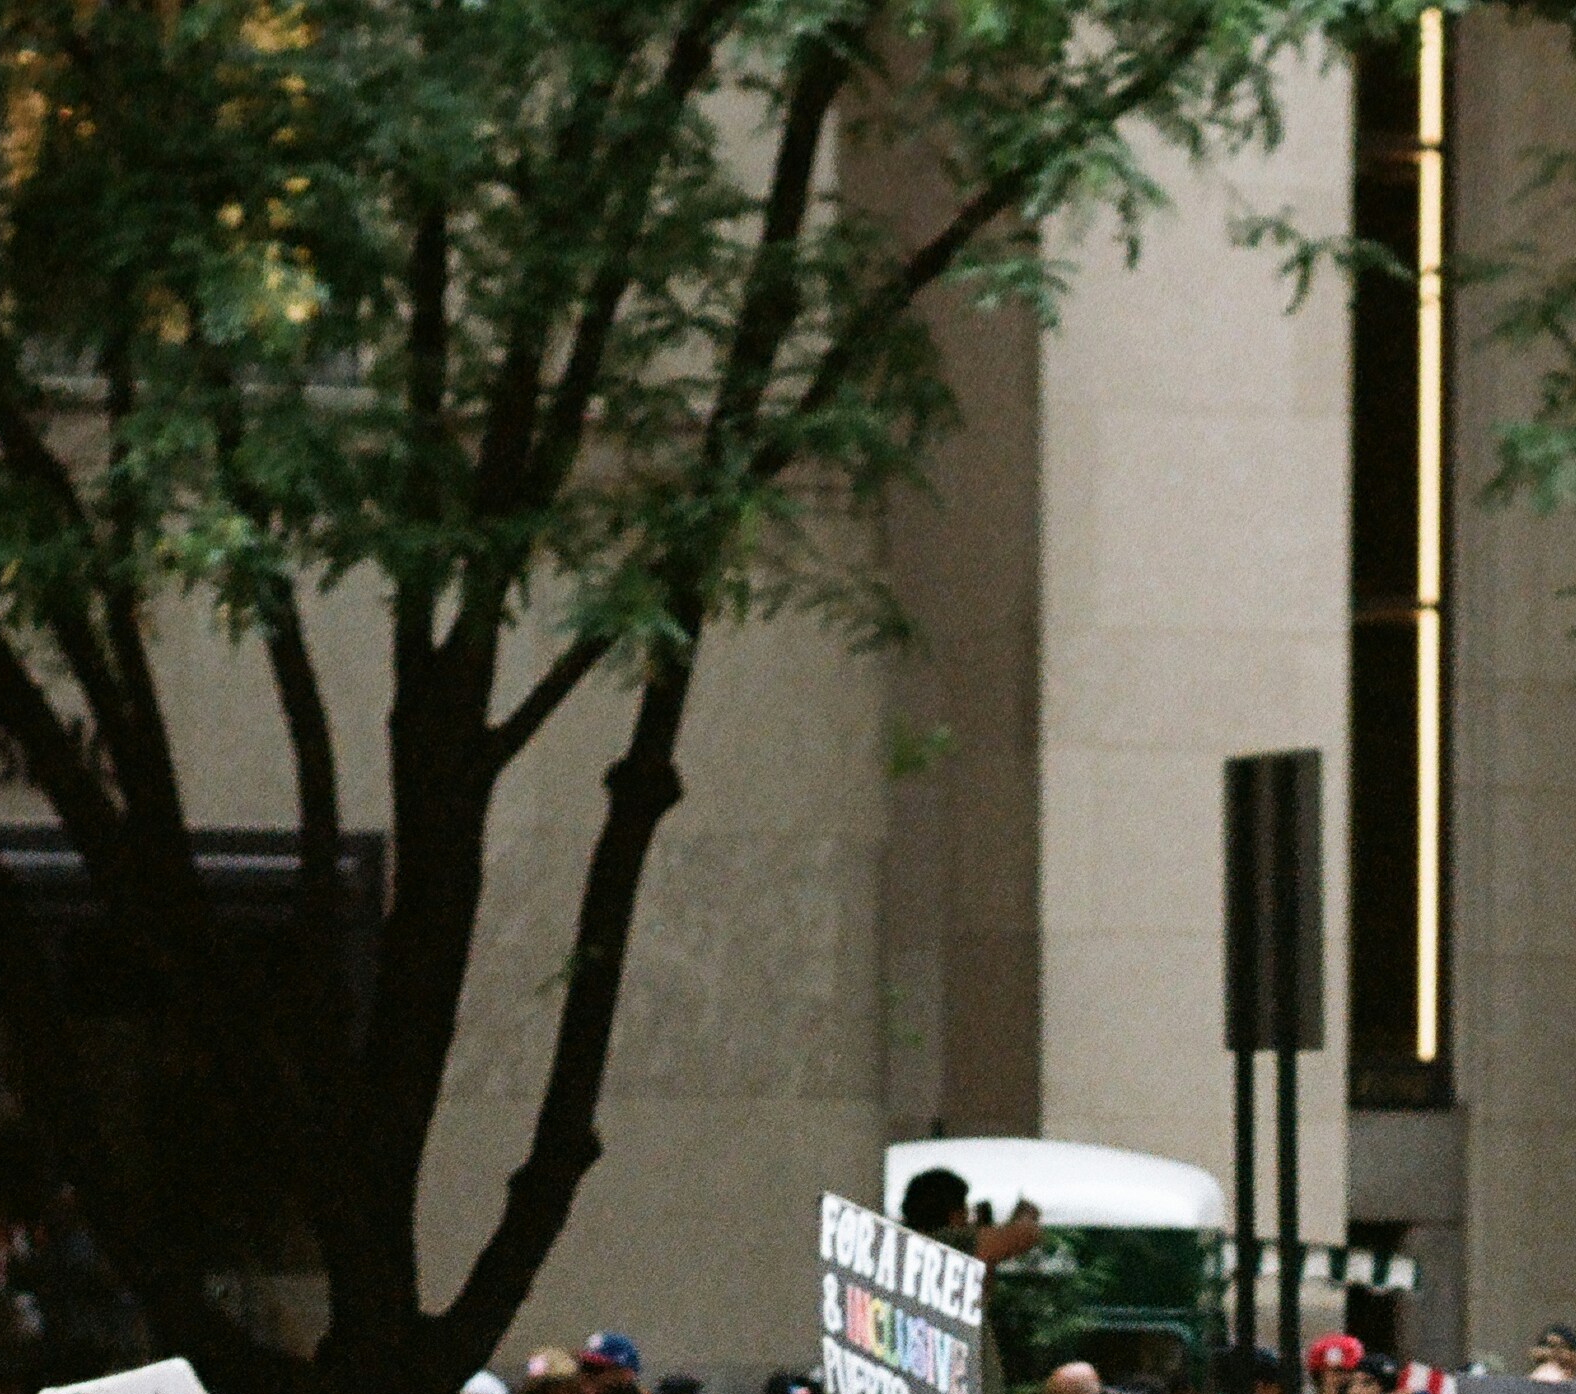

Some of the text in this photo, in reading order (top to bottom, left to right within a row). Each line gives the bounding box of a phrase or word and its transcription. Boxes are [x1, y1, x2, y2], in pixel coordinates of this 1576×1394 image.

[820, 1198, 986, 1327] FOR A FREE
[822, 1274, 843, 1333] &
